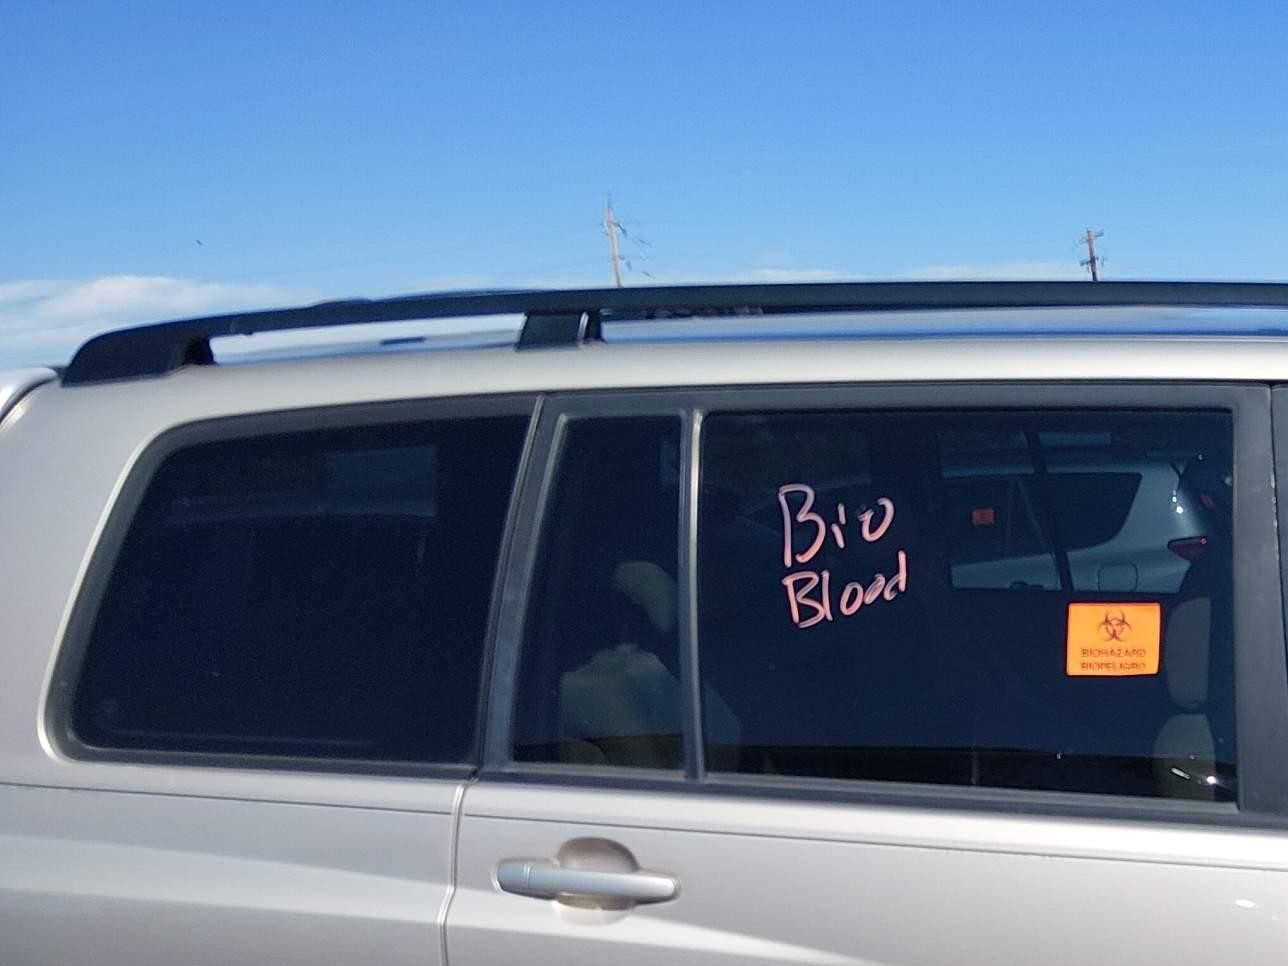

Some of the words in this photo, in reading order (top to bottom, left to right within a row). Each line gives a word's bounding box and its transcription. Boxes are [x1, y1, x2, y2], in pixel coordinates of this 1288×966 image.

[778, 484, 895, 568] Bio
[781, 550, 908, 628] Blood
[1080, 648, 1147, 658] BIOHAZARD
